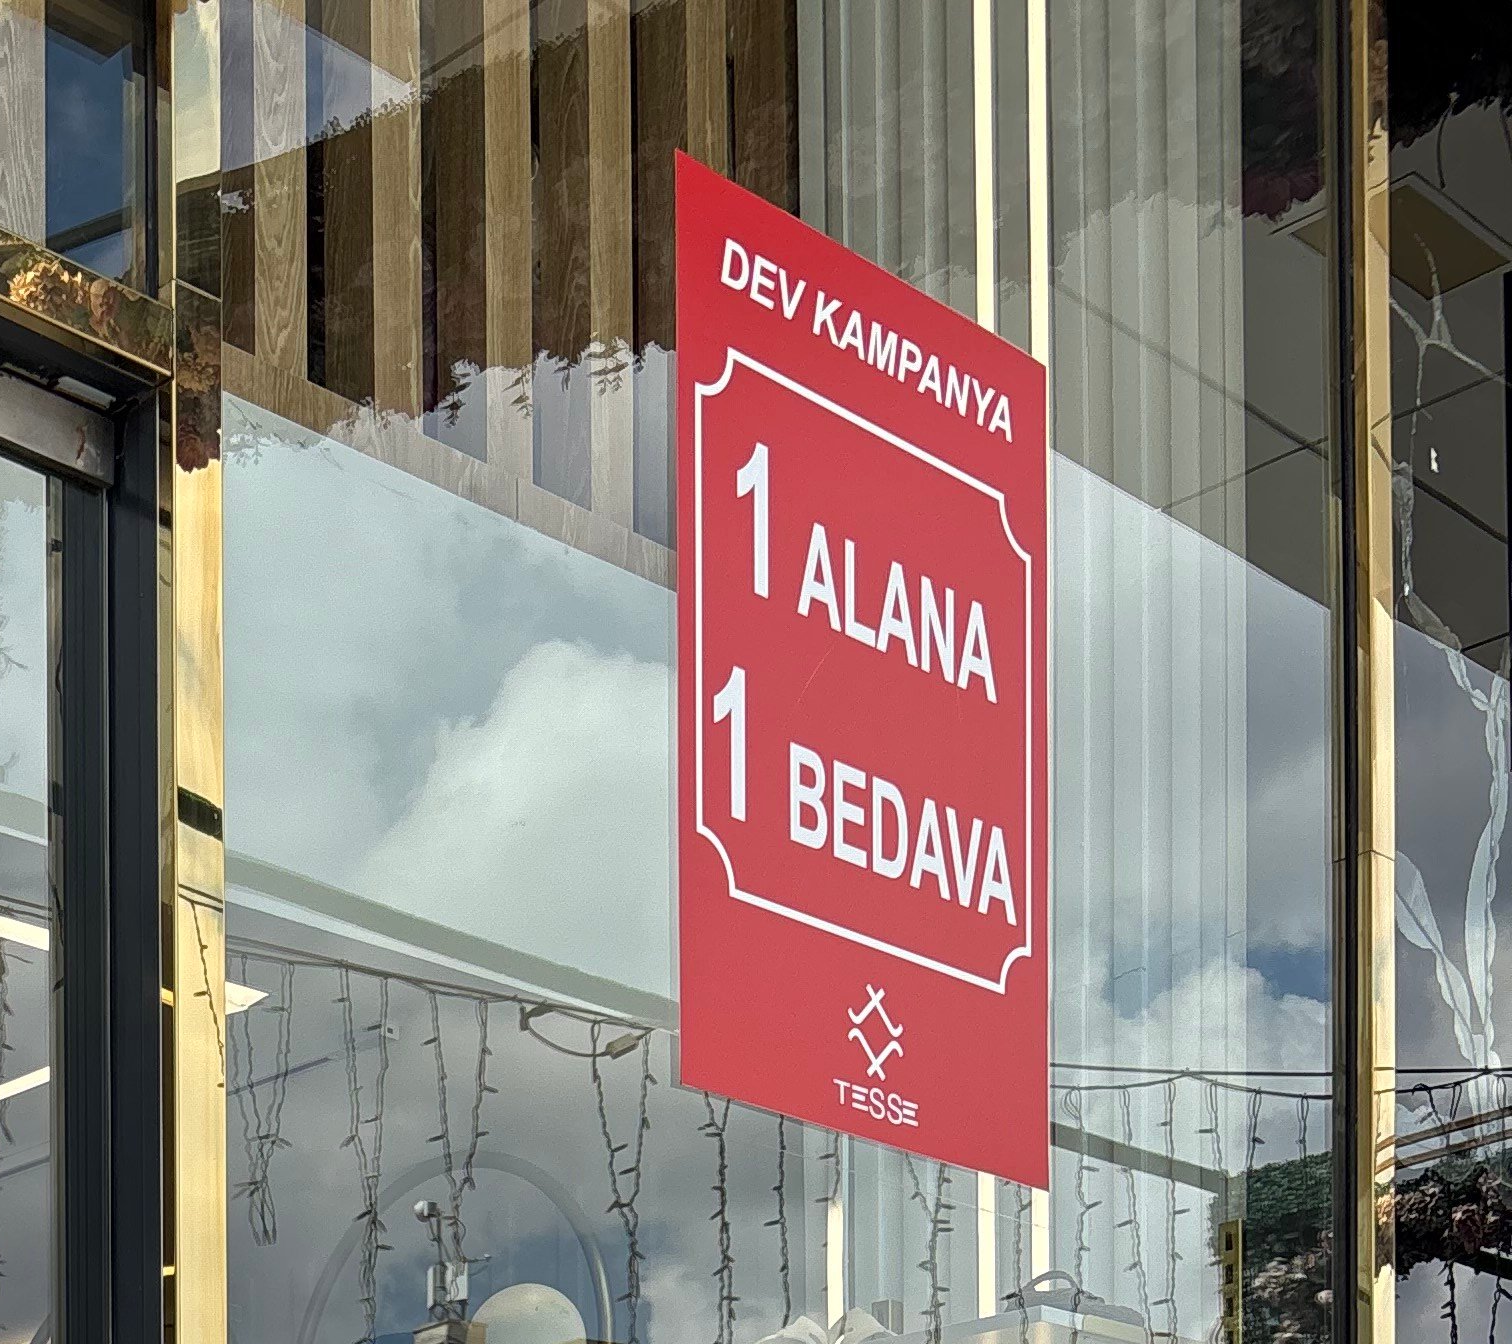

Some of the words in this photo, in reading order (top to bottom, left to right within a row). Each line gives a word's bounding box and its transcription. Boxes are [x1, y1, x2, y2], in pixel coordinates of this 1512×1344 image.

[720, 237, 807, 321] DEV
[812, 290, 1014, 444] KAMPANYA
[736, 442, 769, 599] 1
[797, 522, 998, 704] ALANA
[713, 665, 746, 822] 1
[789, 741, 1018, 927] BEDAVA
[833, 1078, 919, 1128] TESSE
